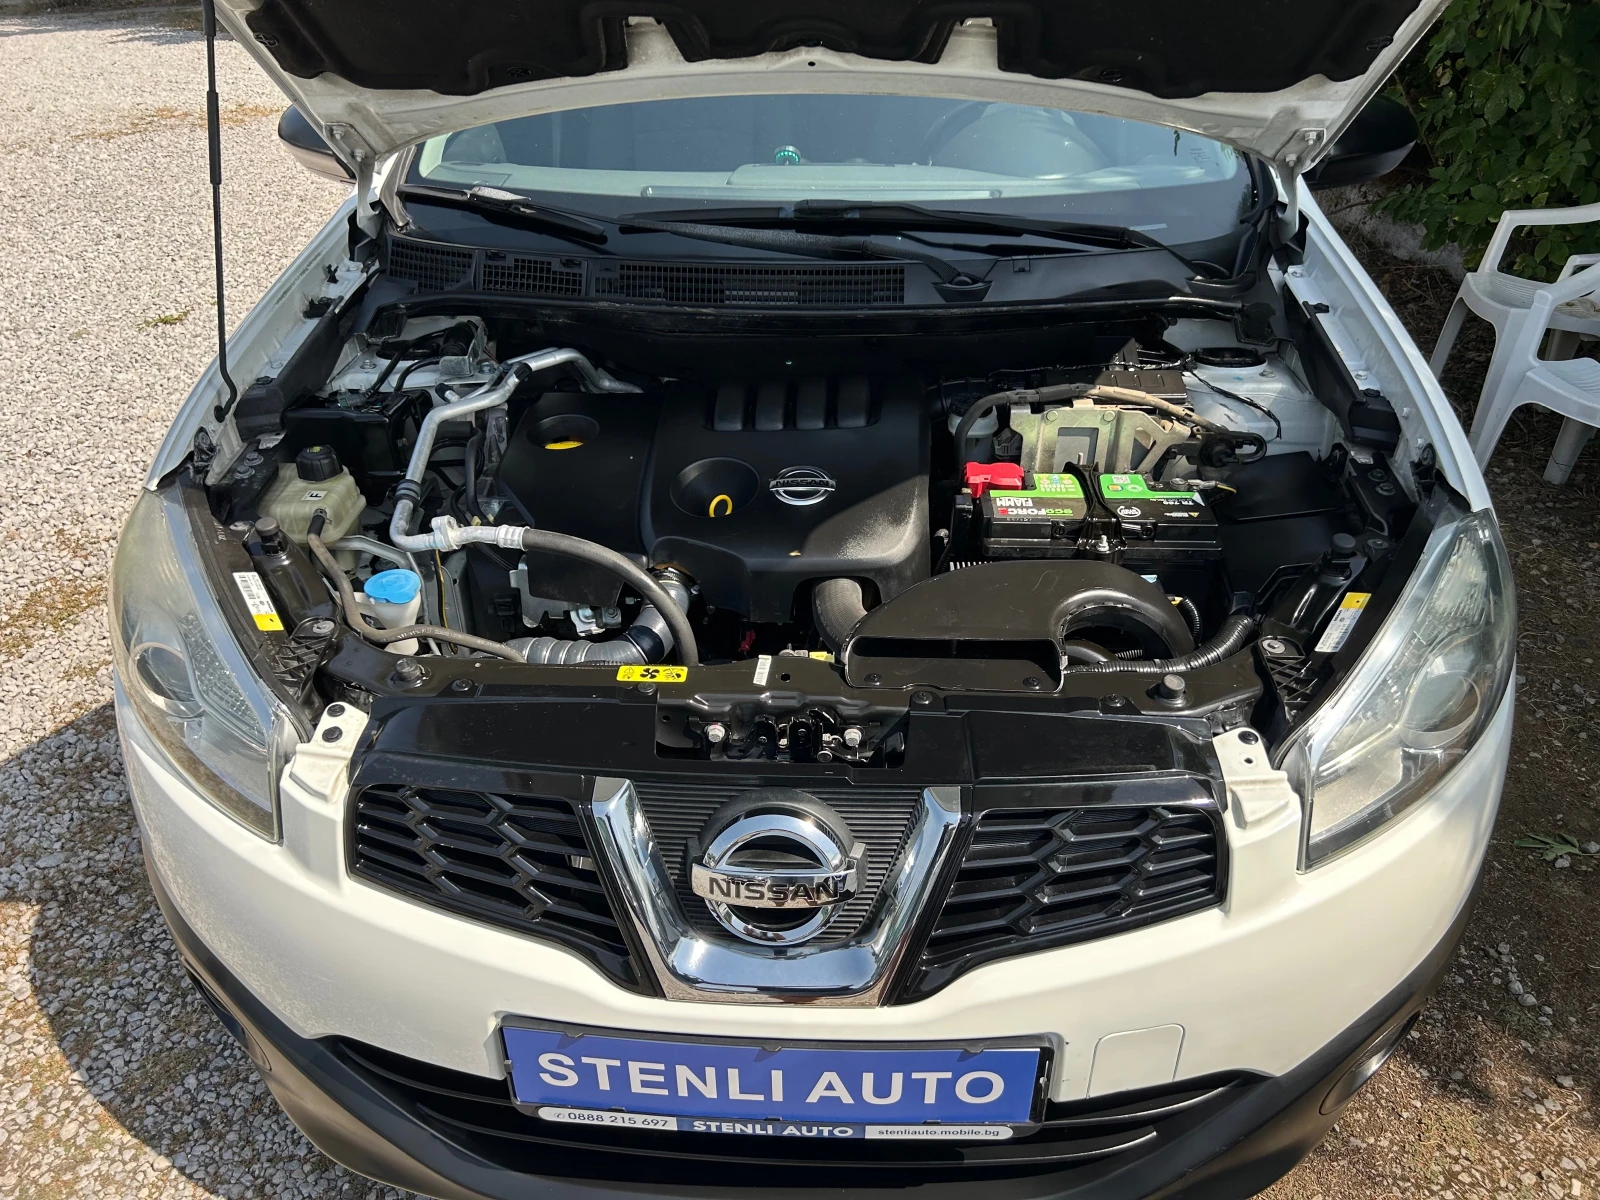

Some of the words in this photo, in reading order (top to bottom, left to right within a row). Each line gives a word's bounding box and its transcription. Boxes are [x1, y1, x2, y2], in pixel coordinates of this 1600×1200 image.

[775, 479, 830, 487] NISSAN
[996, 497, 1034, 507] FIAMM
[708, 877, 839, 902] NISSAN
[538, 1052, 784, 1102] STENLI
[805, 1070, 1005, 1105] AUTO
[567, 1111, 605, 1123] 0888
[609, 1115, 637, 1125] 215
[641, 1116, 669, 1128] 697
[692, 1120, 774, 1135] STENLI
[781, 1125, 854, 1137] AUTO
[877, 1129, 1000, 1137] stenliauto.mobile.bg
